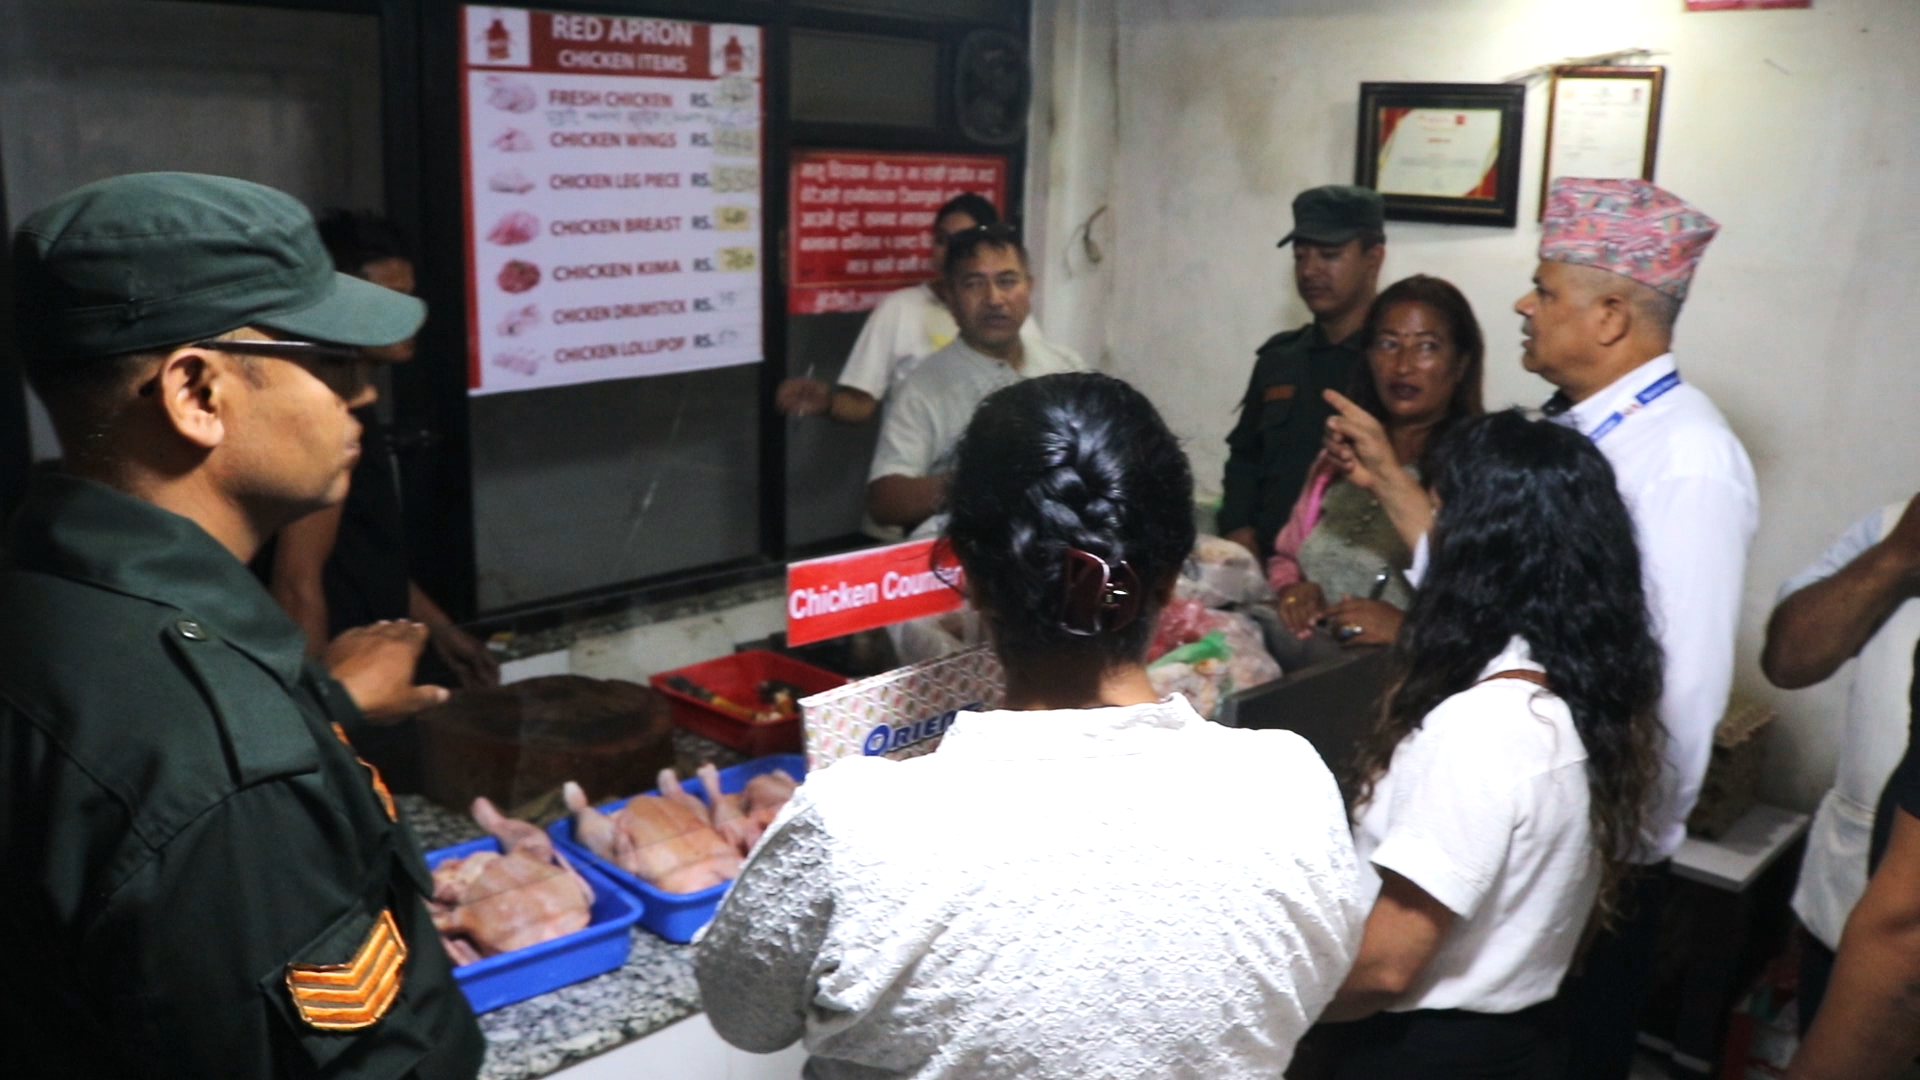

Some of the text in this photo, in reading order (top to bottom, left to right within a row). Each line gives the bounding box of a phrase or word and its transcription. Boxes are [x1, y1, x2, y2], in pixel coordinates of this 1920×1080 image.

[552, 15, 693, 46] RED APRON
[557, 49, 688, 72] CHICKEN ITEMS
[549, 90, 600, 107] FRESH
[605, 91, 673, 107] CHICKEN
[550, 132, 621, 148] CHICKEN
[626, 132, 677, 148] WINGS
[550, 174, 612, 189] CHICKEN
[615, 173, 641, 188] LEG
[644, 172, 680, 188] PIECE
[550, 218, 621, 236] CHICKEN
[625, 216, 682, 232] BREAST
[553, 262, 632, 282] CHICKEN
[638, 260, 681, 276] KIMA
[553, 306, 611, 325] CHICKEN
[615, 299, 687, 319] DRUMSTICK
[554, 343, 617, 363] CHICKEN
[621, 337, 686, 357] LOLLIPOP
[788, 565, 963, 620] Chicken Counter
